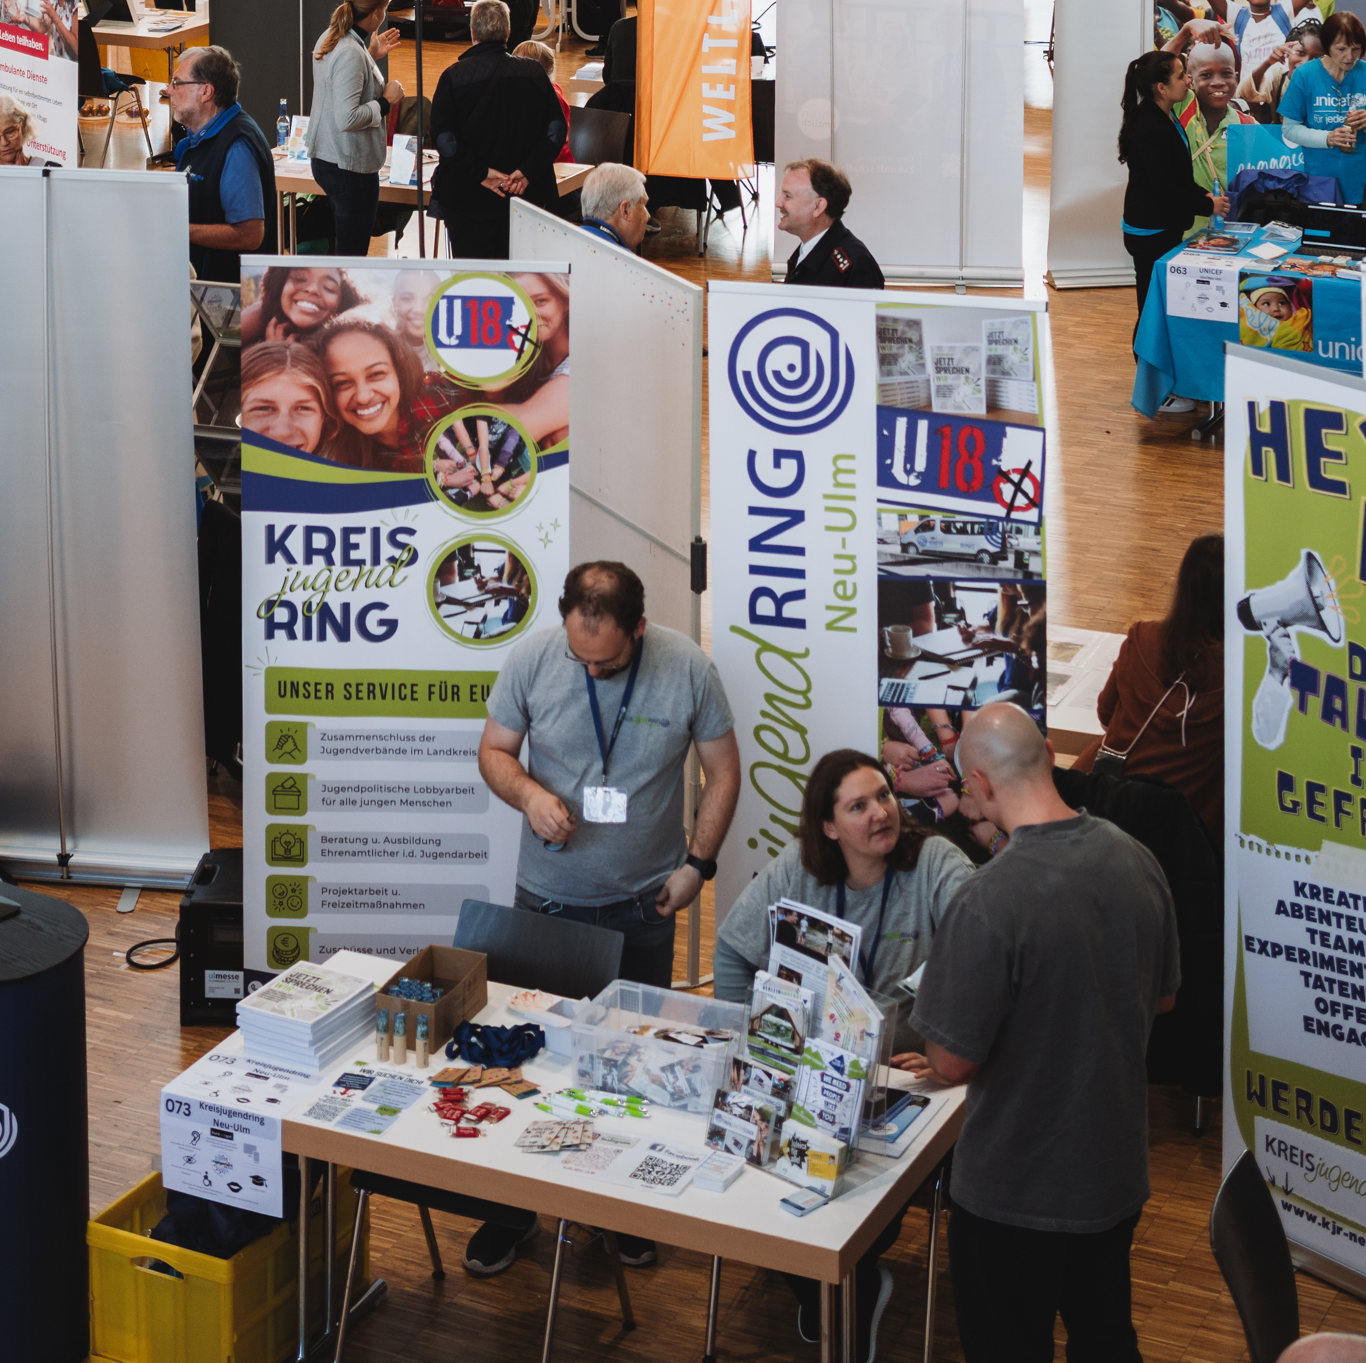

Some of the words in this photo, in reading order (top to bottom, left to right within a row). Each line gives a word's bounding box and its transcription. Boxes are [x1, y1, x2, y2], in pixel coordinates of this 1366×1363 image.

[0, 29, 14, 43] Leben
[16, 33, 44, 51] teilhaben.
[26, 68, 47, 84] Dienste
[1169, 266, 1187, 275] 063
[1199, 267, 1223, 275] UNICEF
[437, 298, 502, 346] U18
[264, 524, 419, 566] KREIS
[824, 453, 857, 633] Neu-Ulm
[257, 545, 414, 619] jugend
[264, 600, 399, 642] RING
[278, 681, 334, 700] UNSER
[344, 683, 418, 701] SERVICE
[428, 682, 460, 701] FÜR
[320, 733, 415, 743] Zusammenschluss
[320, 745, 407, 756] Jugendverbände
[427, 747, 477, 757] Landkreis
[321, 784, 411, 795] Jugendpolitische
[413, 785, 475, 796] Lobbyarbeit
[339, 798, 356, 807] alle
[359, 798, 396, 808] jungen
[400, 798, 452, 808] Menschen
[321, 836, 368, 846] Beratung
[383, 836, 441, 847] Ausbildung
[321, 849, 399, 858] Ehrenamtlicher
[419, 849, 487, 860] Jugendarbeit
[321, 887, 388, 897] Projektarbeit
[321, 900, 425, 910] Freizeitmaßnahmen
[208, 973, 239, 981] ulmesse
[281, 977, 334, 995] SPRECHEN
[165, 1099, 191, 1117] 073
[199, 1101, 265, 1127] Kreisjugendring
[1245, 1068, 1363, 1147] WERDE
[213, 1119, 251, 1135] Neu-Ulm
